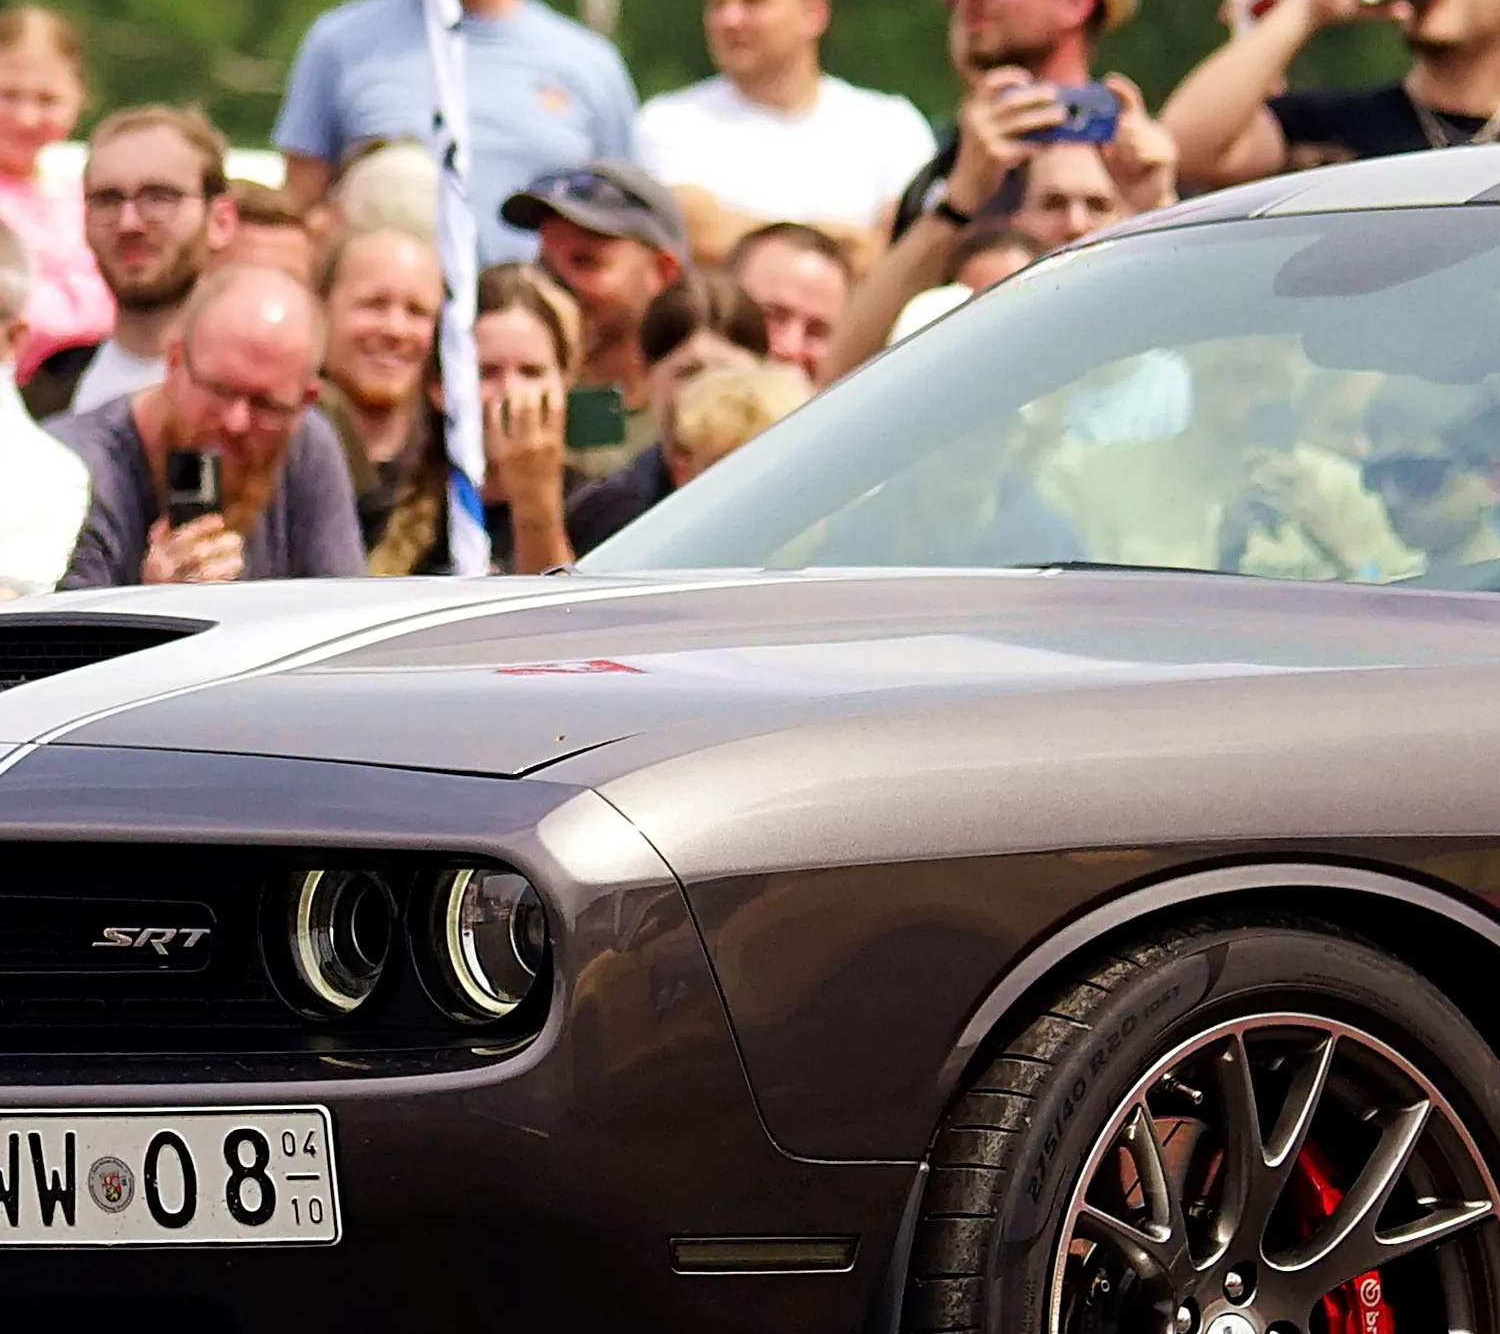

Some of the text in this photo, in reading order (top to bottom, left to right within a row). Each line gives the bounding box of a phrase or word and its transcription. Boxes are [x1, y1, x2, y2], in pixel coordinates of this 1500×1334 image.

[91, 927, 212, 956] SRT
[1026, 1077, 1087, 1205] 275/40
[1089, 1014, 1137, 1077] R20
[281, 1128, 319, 1159] 04
[223, 1126, 278, 1227] 8
[290, 1194, 325, 1226] 10
